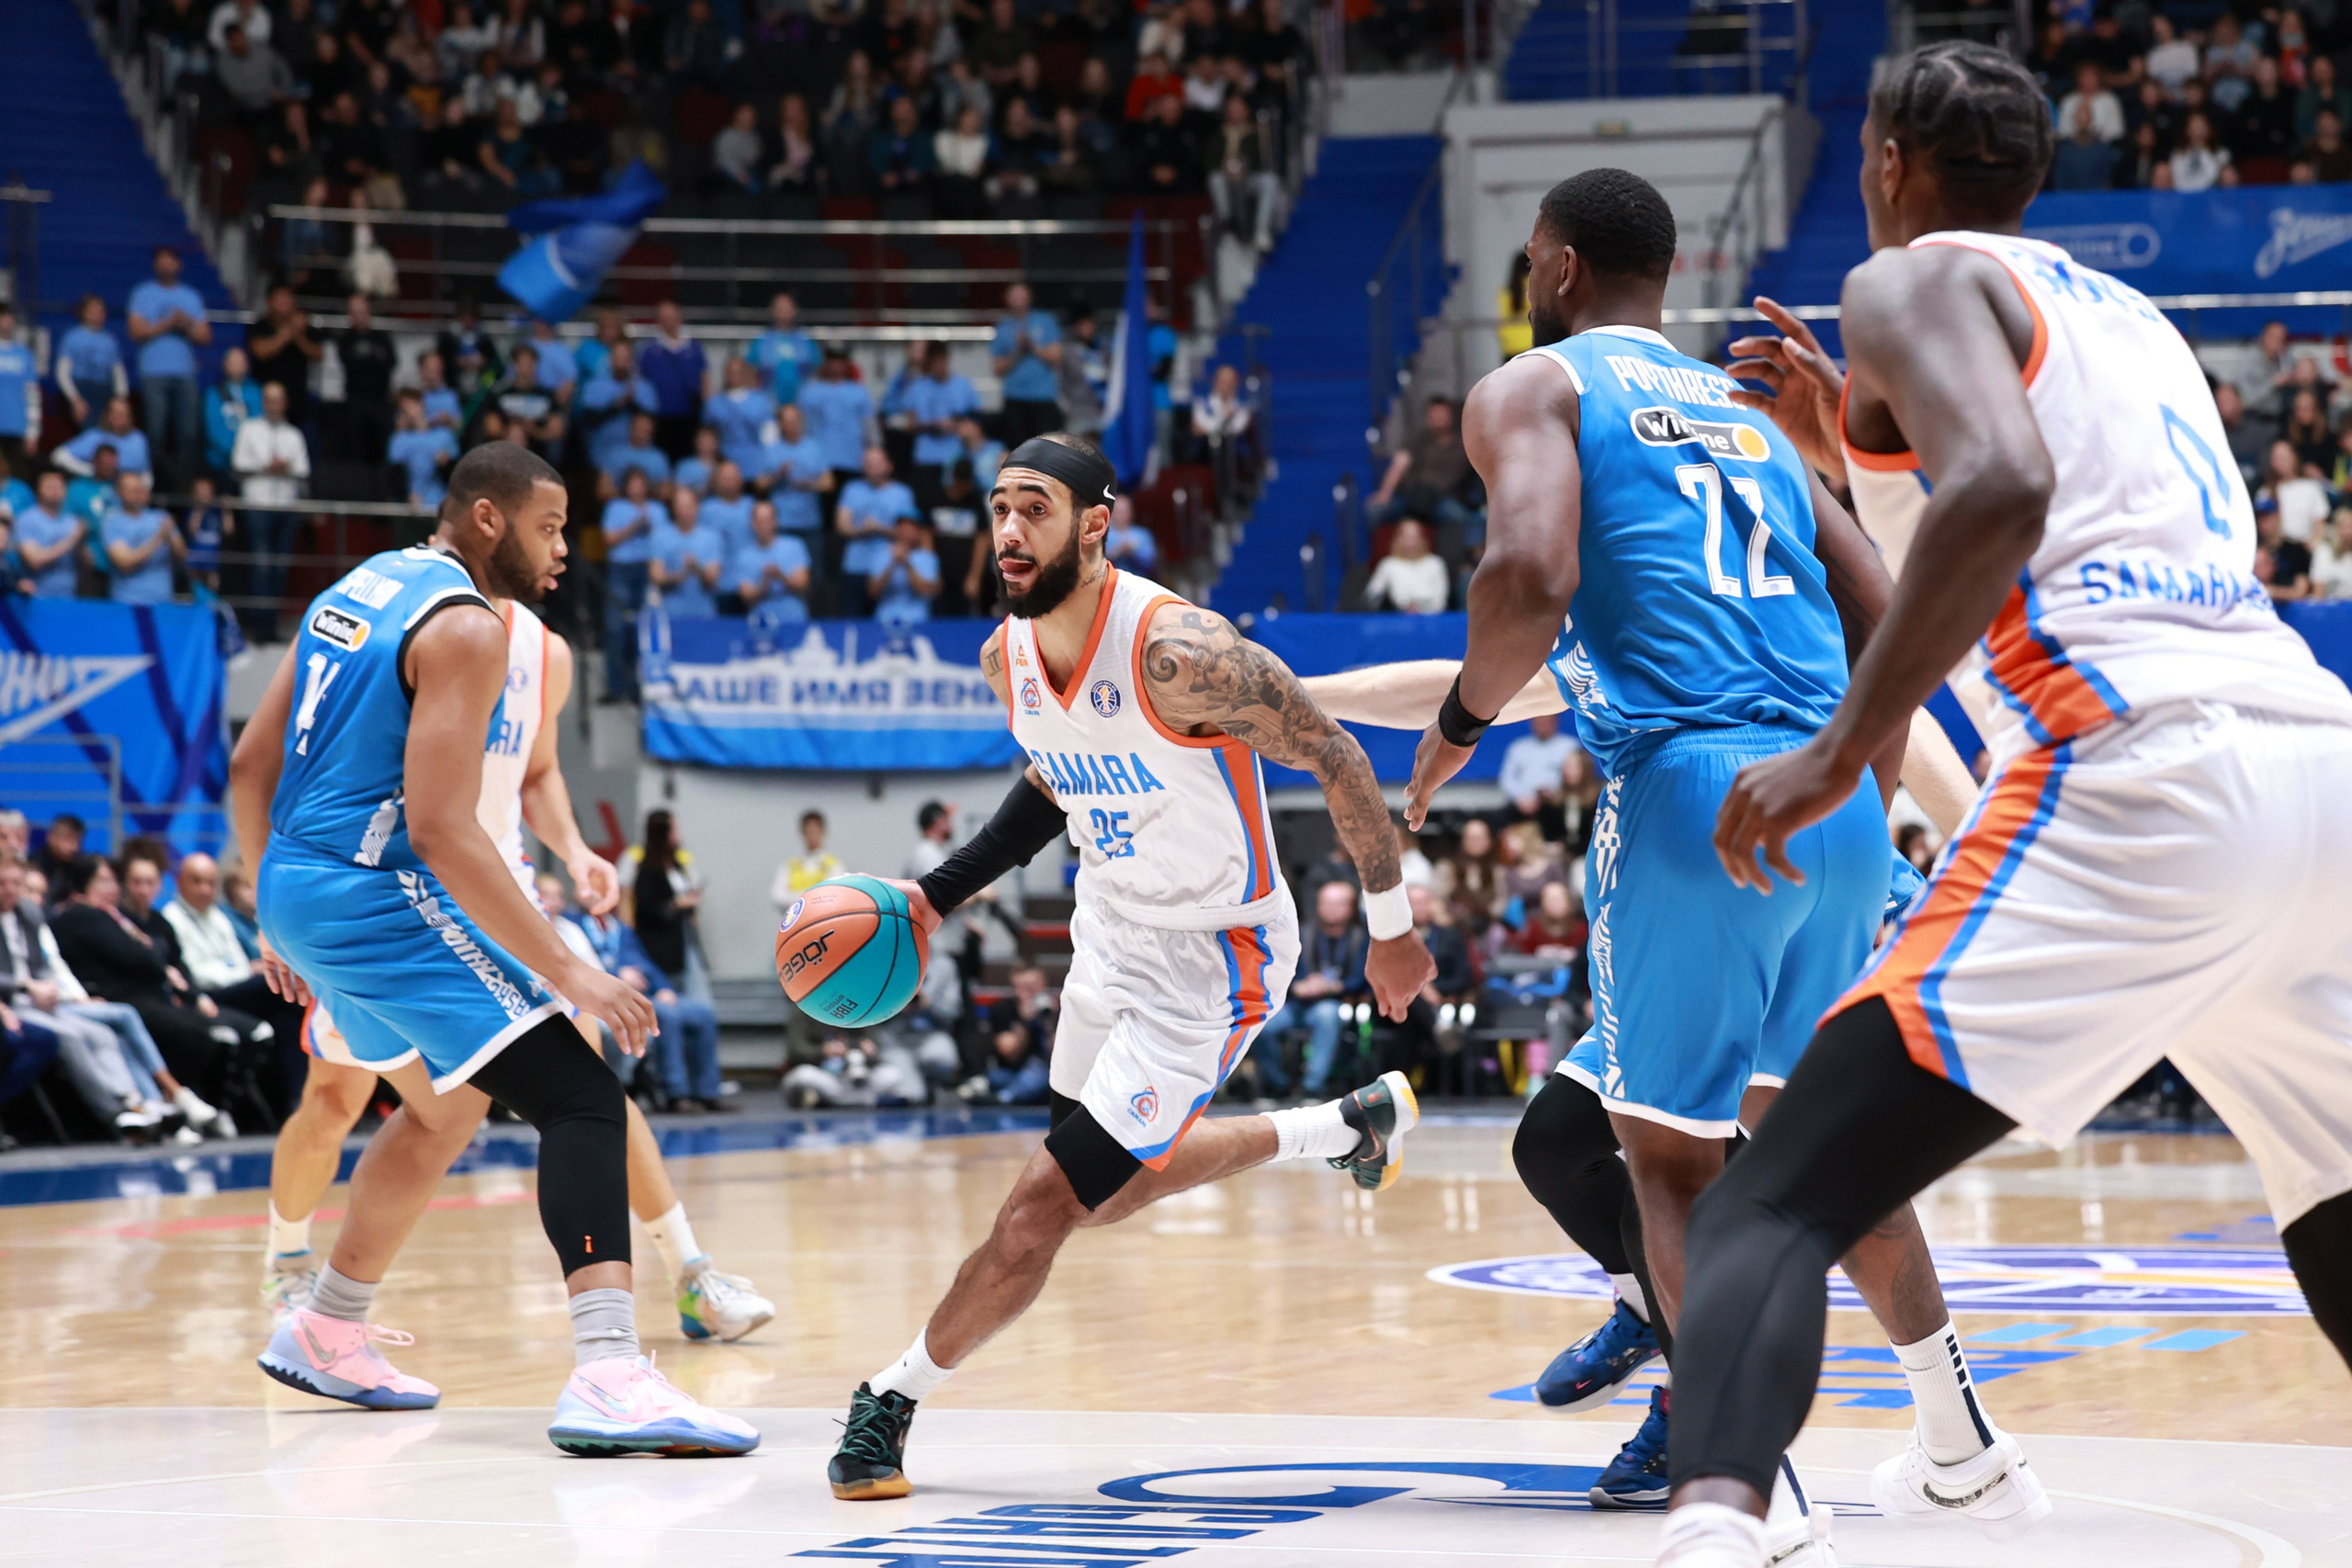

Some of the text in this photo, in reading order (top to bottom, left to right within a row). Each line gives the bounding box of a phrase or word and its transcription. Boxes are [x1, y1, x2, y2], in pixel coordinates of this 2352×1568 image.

[1674, 462, 1796, 598] 22
[676, 676, 778, 705] АШЕ
[1029, 749, 1166, 795] SAMARA
[1089, 807, 1136, 861] 25
